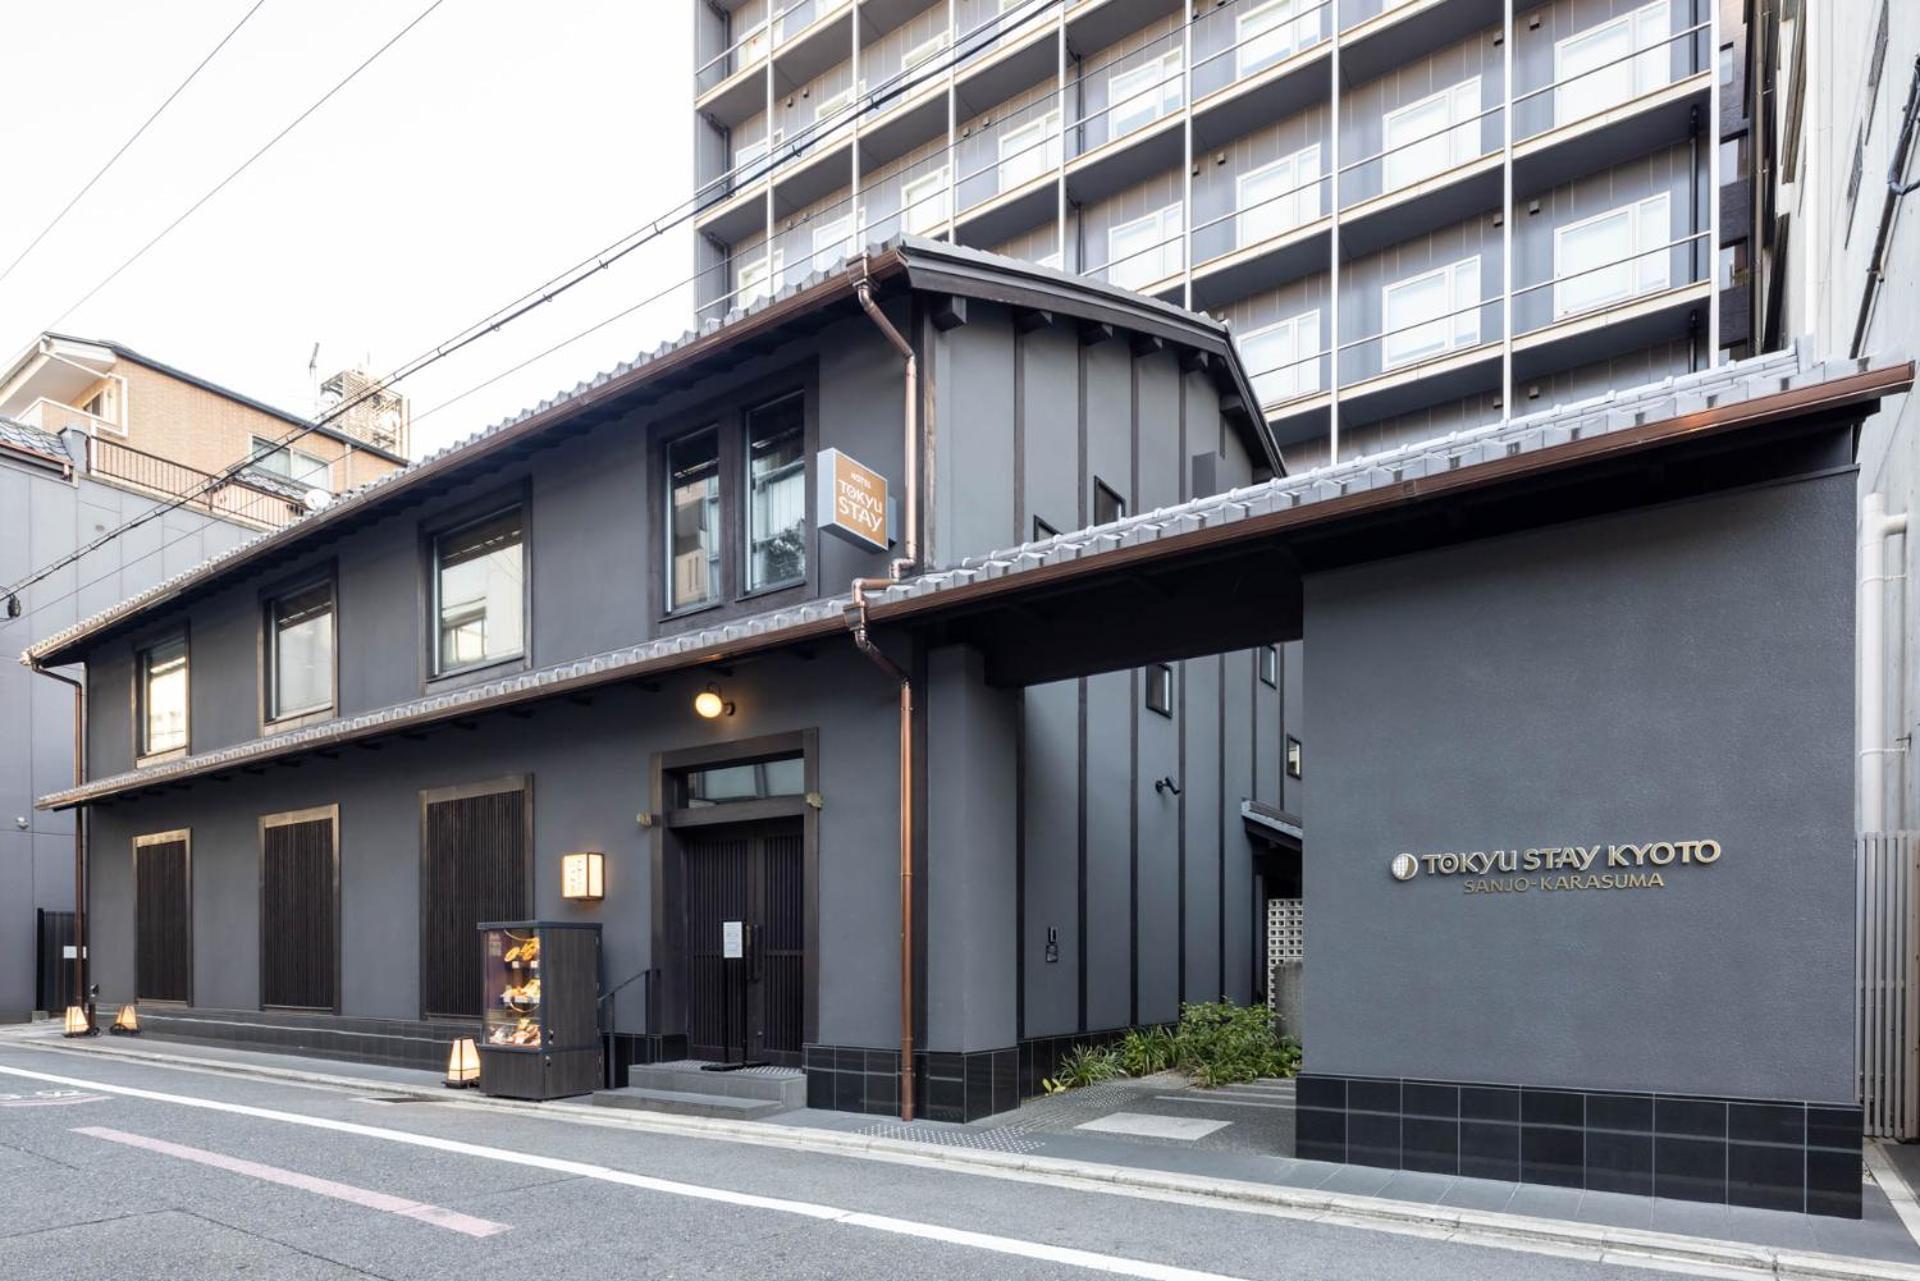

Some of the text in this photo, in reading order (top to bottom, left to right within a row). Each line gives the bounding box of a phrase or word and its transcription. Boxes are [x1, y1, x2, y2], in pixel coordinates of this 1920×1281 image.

[838, 479, 882, 513] TOKYU
[838, 495, 882, 532] STAY
[1421, 839, 1721, 875] TOKYU STAY KYOTO
